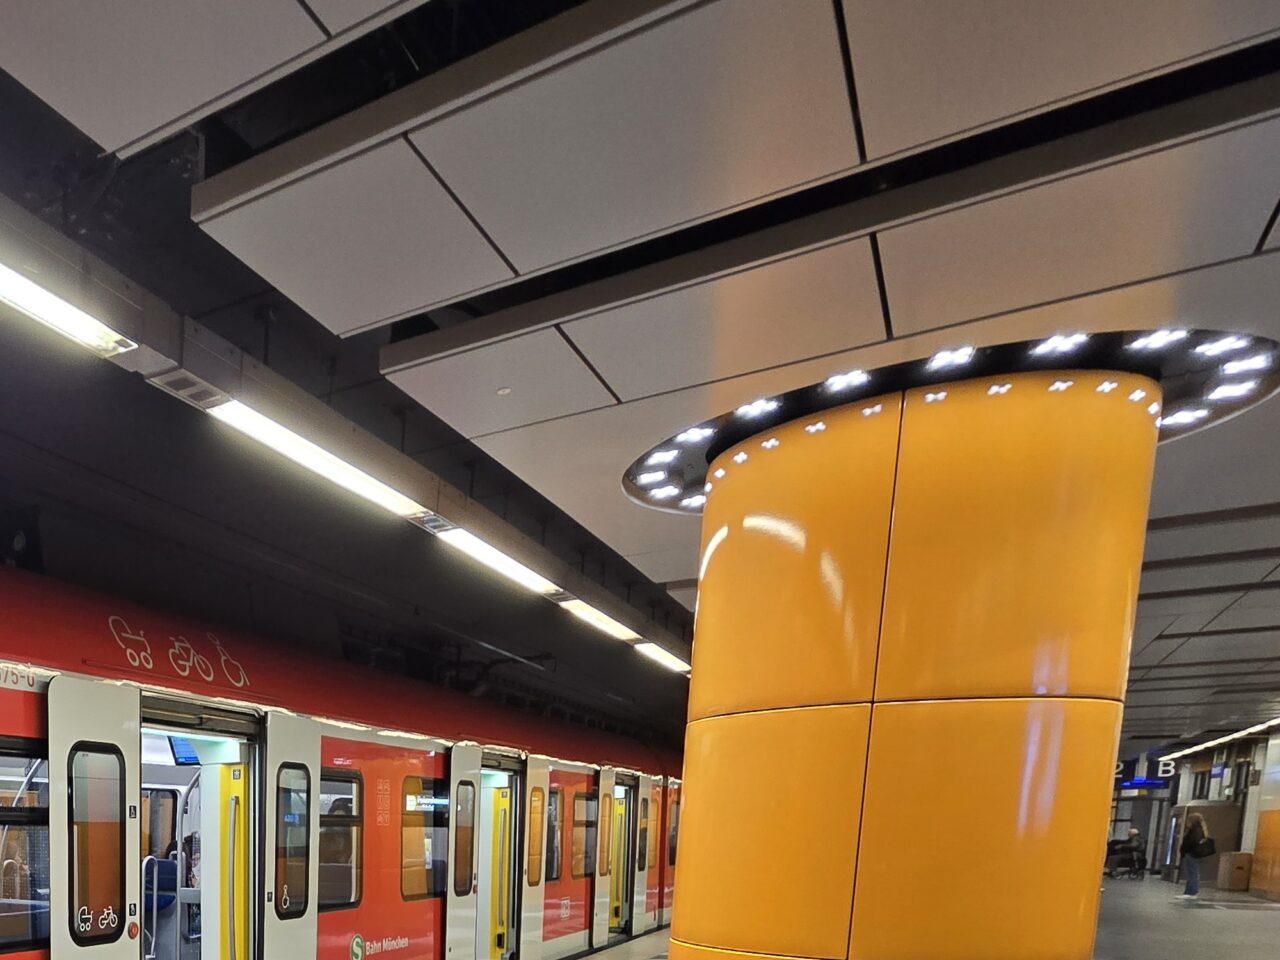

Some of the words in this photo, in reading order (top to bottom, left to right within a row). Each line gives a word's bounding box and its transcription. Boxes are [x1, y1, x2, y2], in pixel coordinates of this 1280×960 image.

[1157, 760, 1176, 778] B
[365, 940, 382, 956] Bahn
[383, 935, 409, 952] München
